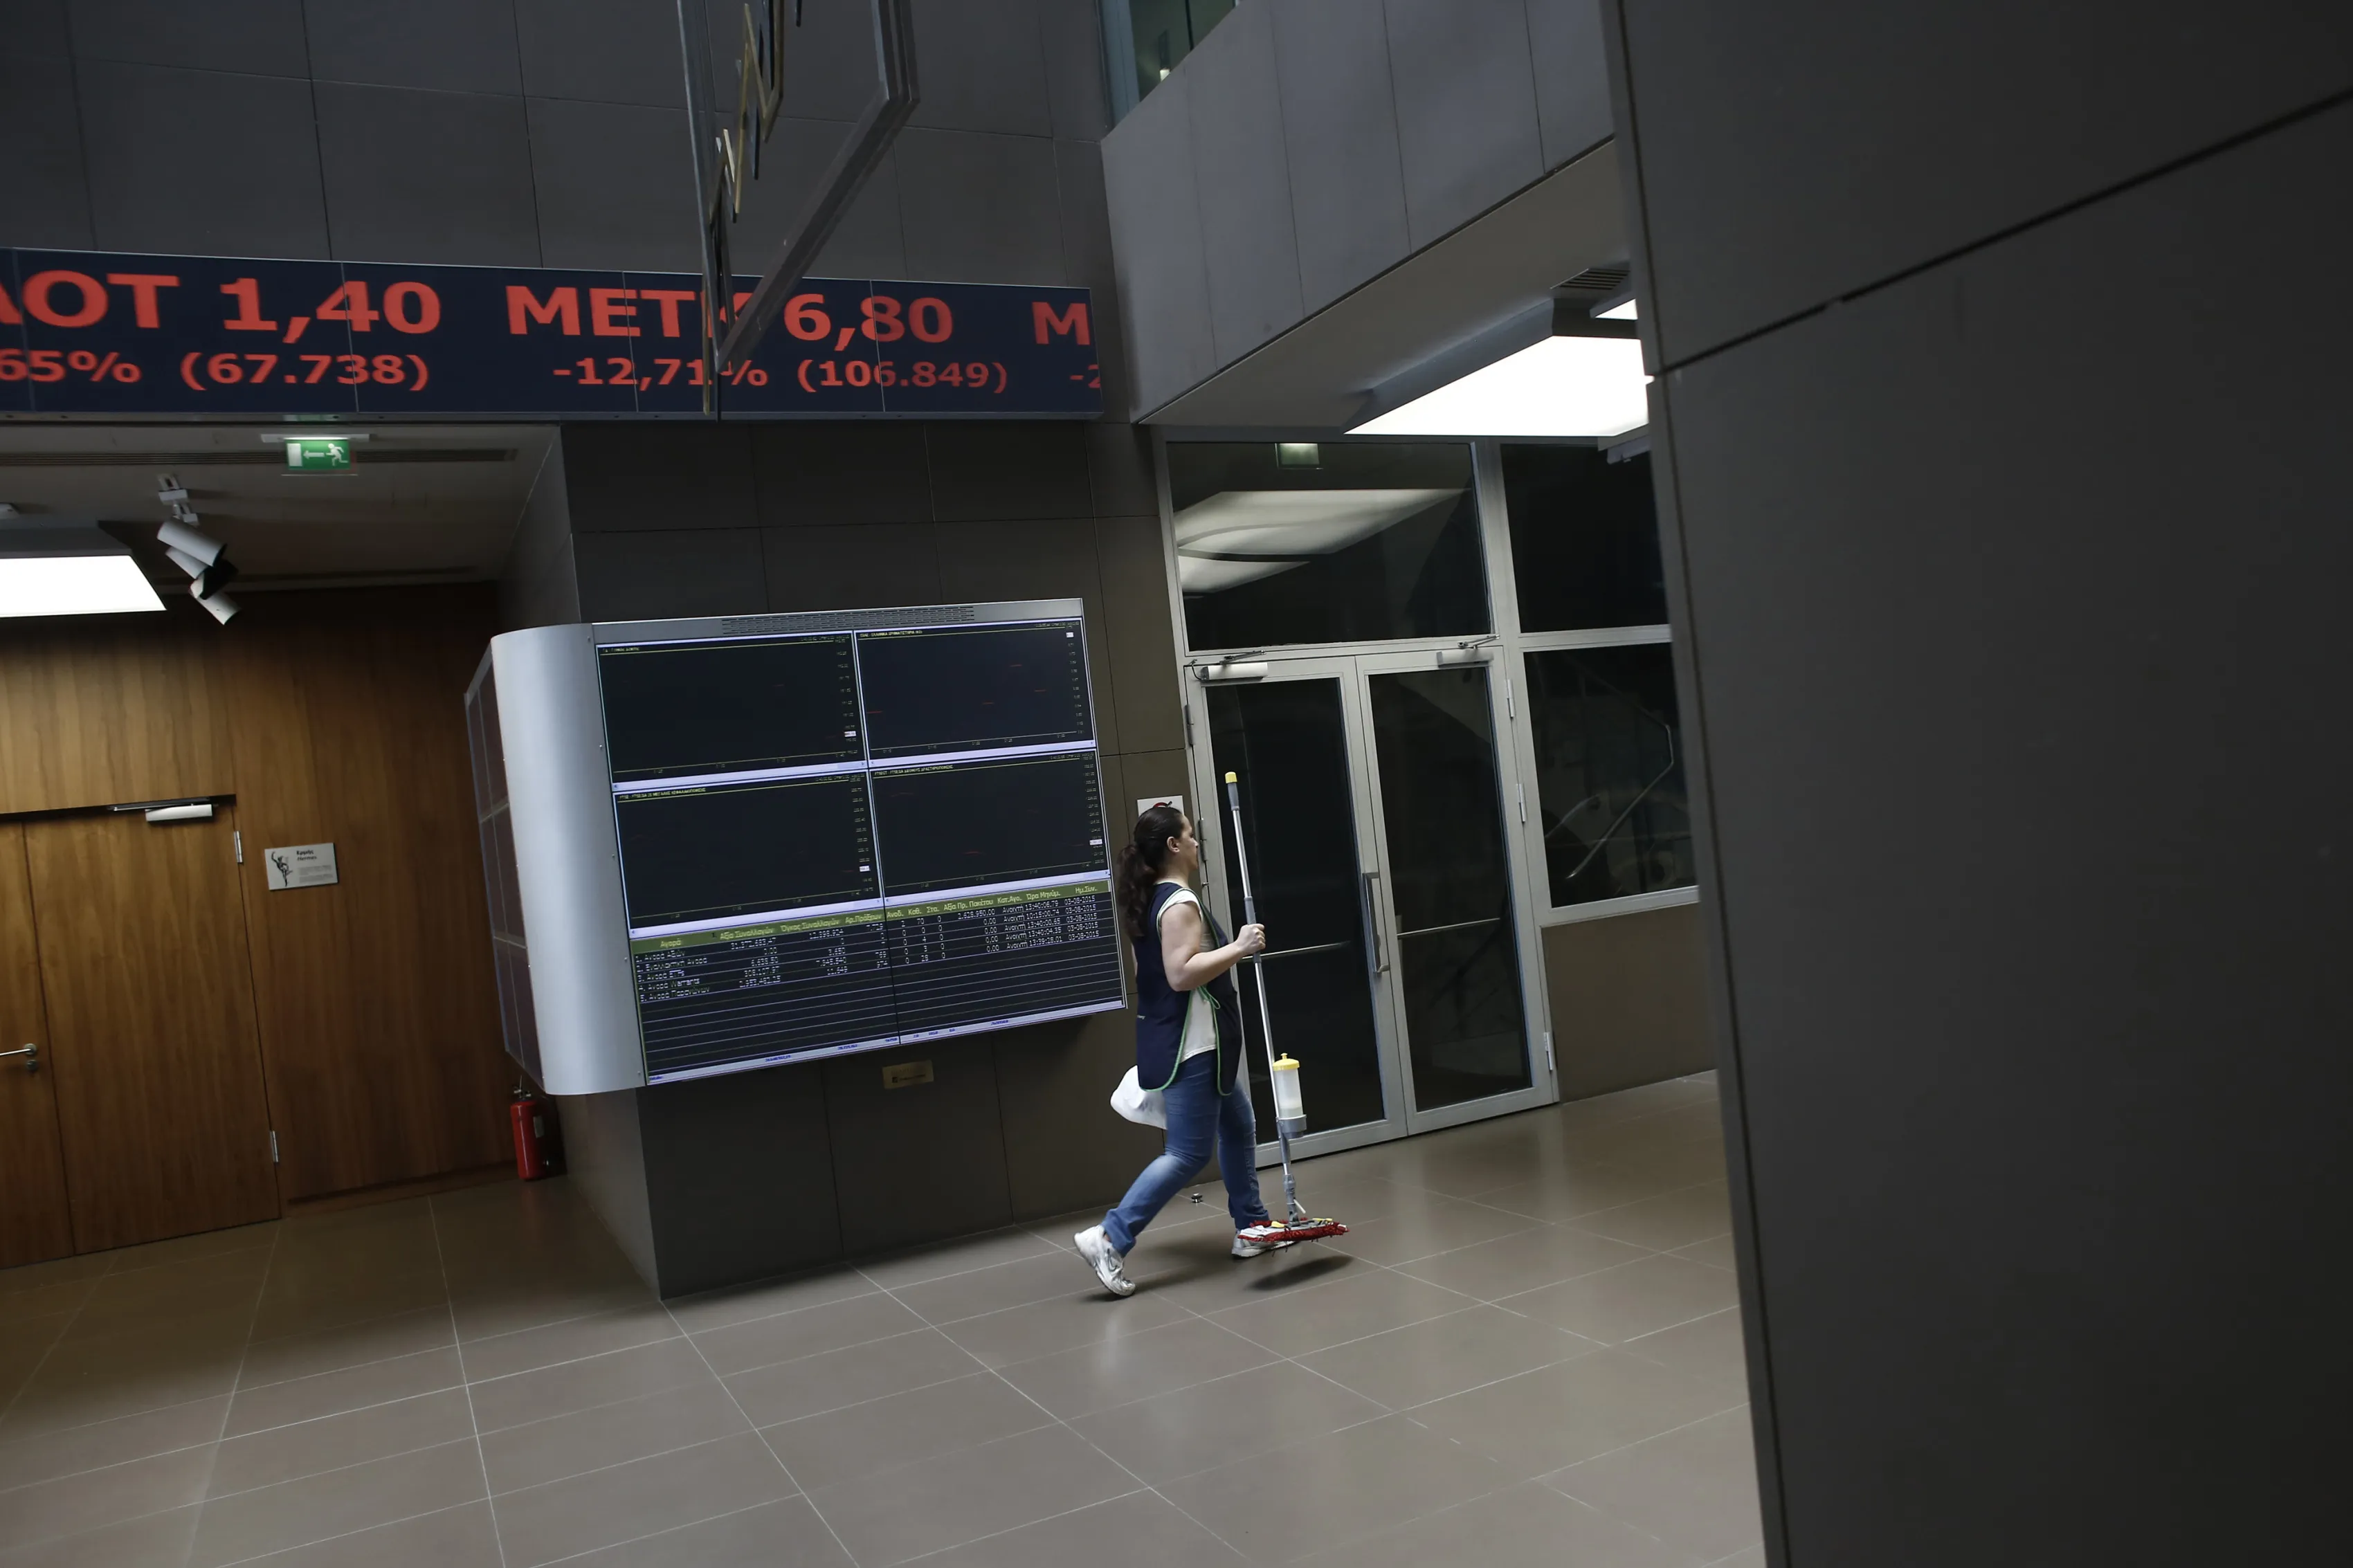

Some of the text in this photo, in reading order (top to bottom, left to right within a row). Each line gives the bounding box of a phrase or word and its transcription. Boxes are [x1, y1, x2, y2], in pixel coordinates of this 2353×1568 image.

[220, 278, 441, 345] 1,40
[784, 293, 953, 351] 6,80
[181, 352, 430, 391] (67.738)
[553, 357, 768, 386] -12,71%
[797, 359, 1007, 393] (106.849)
[900, 920, 906, 928] 2
[937, 915, 942, 923] 0
[1025, 900, 1059, 911] 13:40:06.79
[1064, 895, 1096, 906] 03-08-2015
[902, 929, 907, 937] 0
[1026, 909, 1060, 920] 10:15:00.74
[1065, 904, 1097, 915] 03-08-2015
[908, 907, 922, 916] Καθ.
[927, 905, 940, 913] Στα.
[957, 902, 968, 910] Πρ.
[969, 898, 994, 908] Πακέτου
[922, 936, 927, 944] 4
[1027, 918, 1061, 929] 13:40:00.65
[1066, 913, 1098, 924] 03-08-2015
[923, 945, 928, 953] 3
[1028, 926, 1062, 938] 13:40:04.35
[1067, 921, 1099, 933] 03-08-2015
[1069, 930, 1100, 941] 03-08-2015
